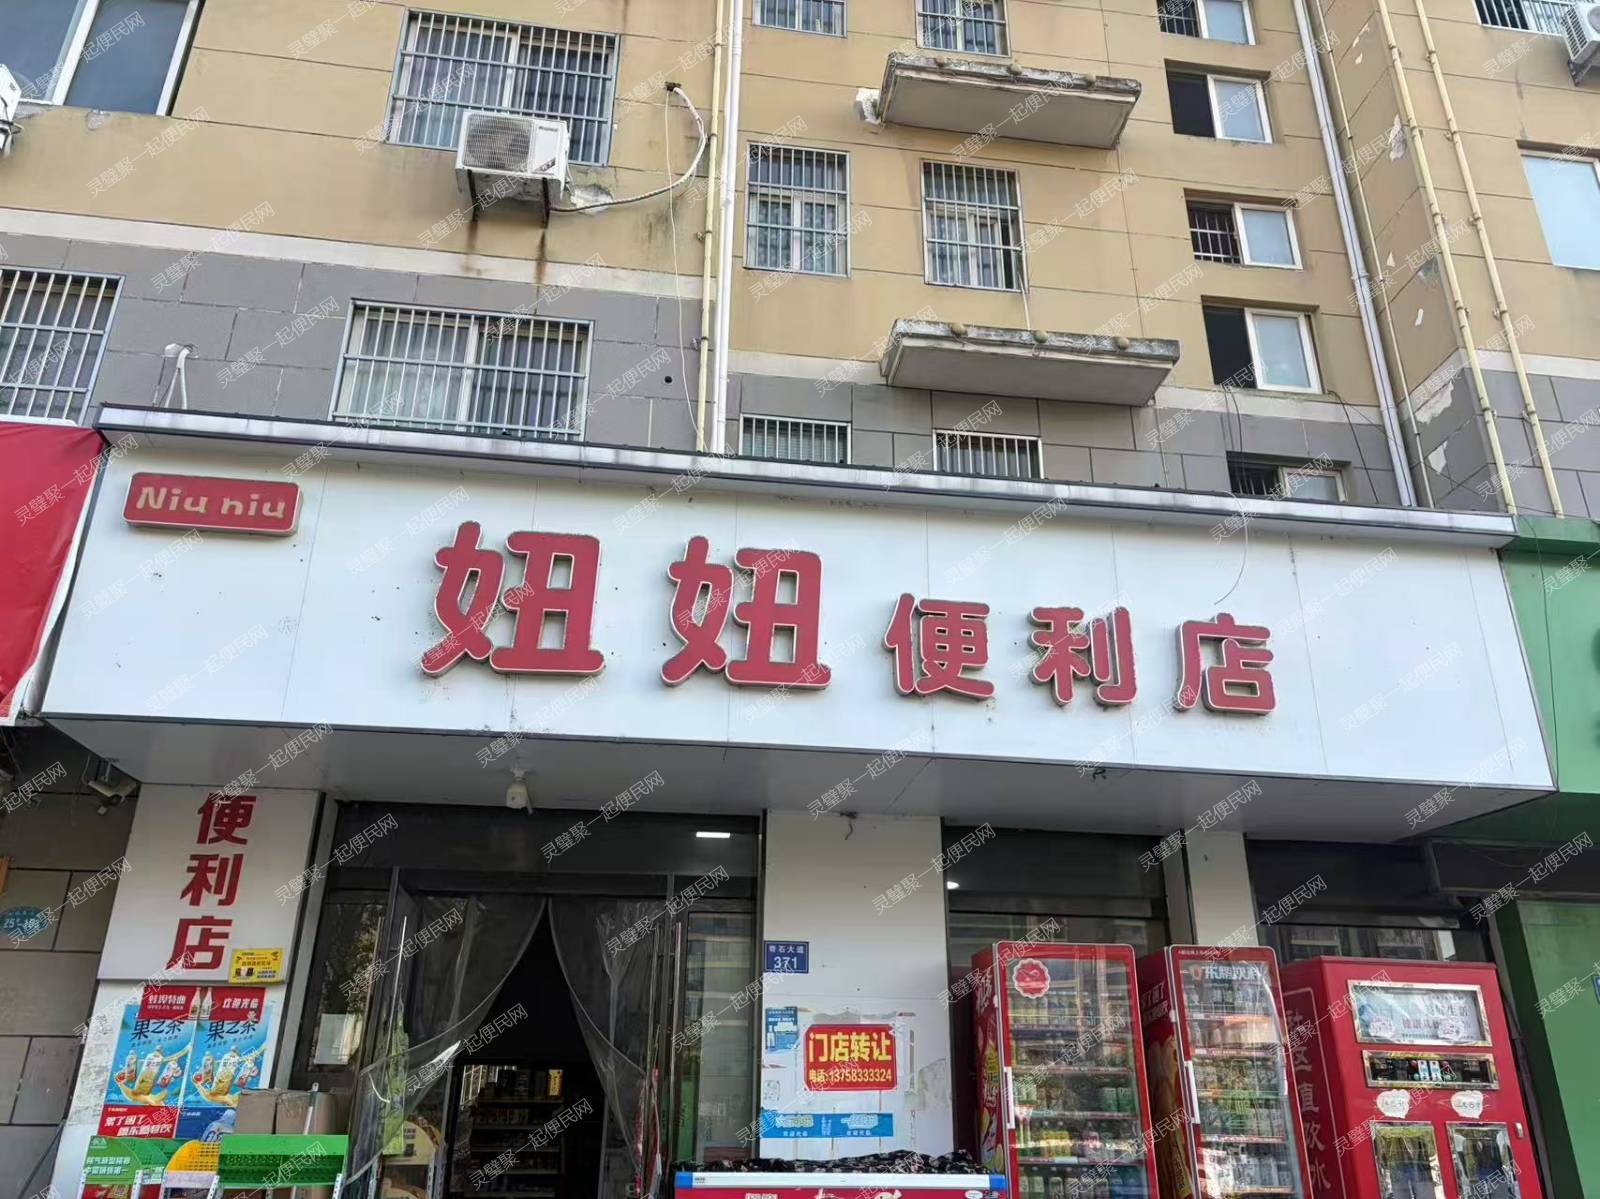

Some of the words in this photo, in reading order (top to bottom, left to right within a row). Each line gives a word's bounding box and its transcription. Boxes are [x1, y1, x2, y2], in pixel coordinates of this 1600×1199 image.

[136, 487, 208, 513] Niu
[220, 493, 285, 518] niu
[165, 793, 257, 972] 便利店
[774, 956, 797, 968] 371
[809, 1032, 892, 1062] 门店转让
